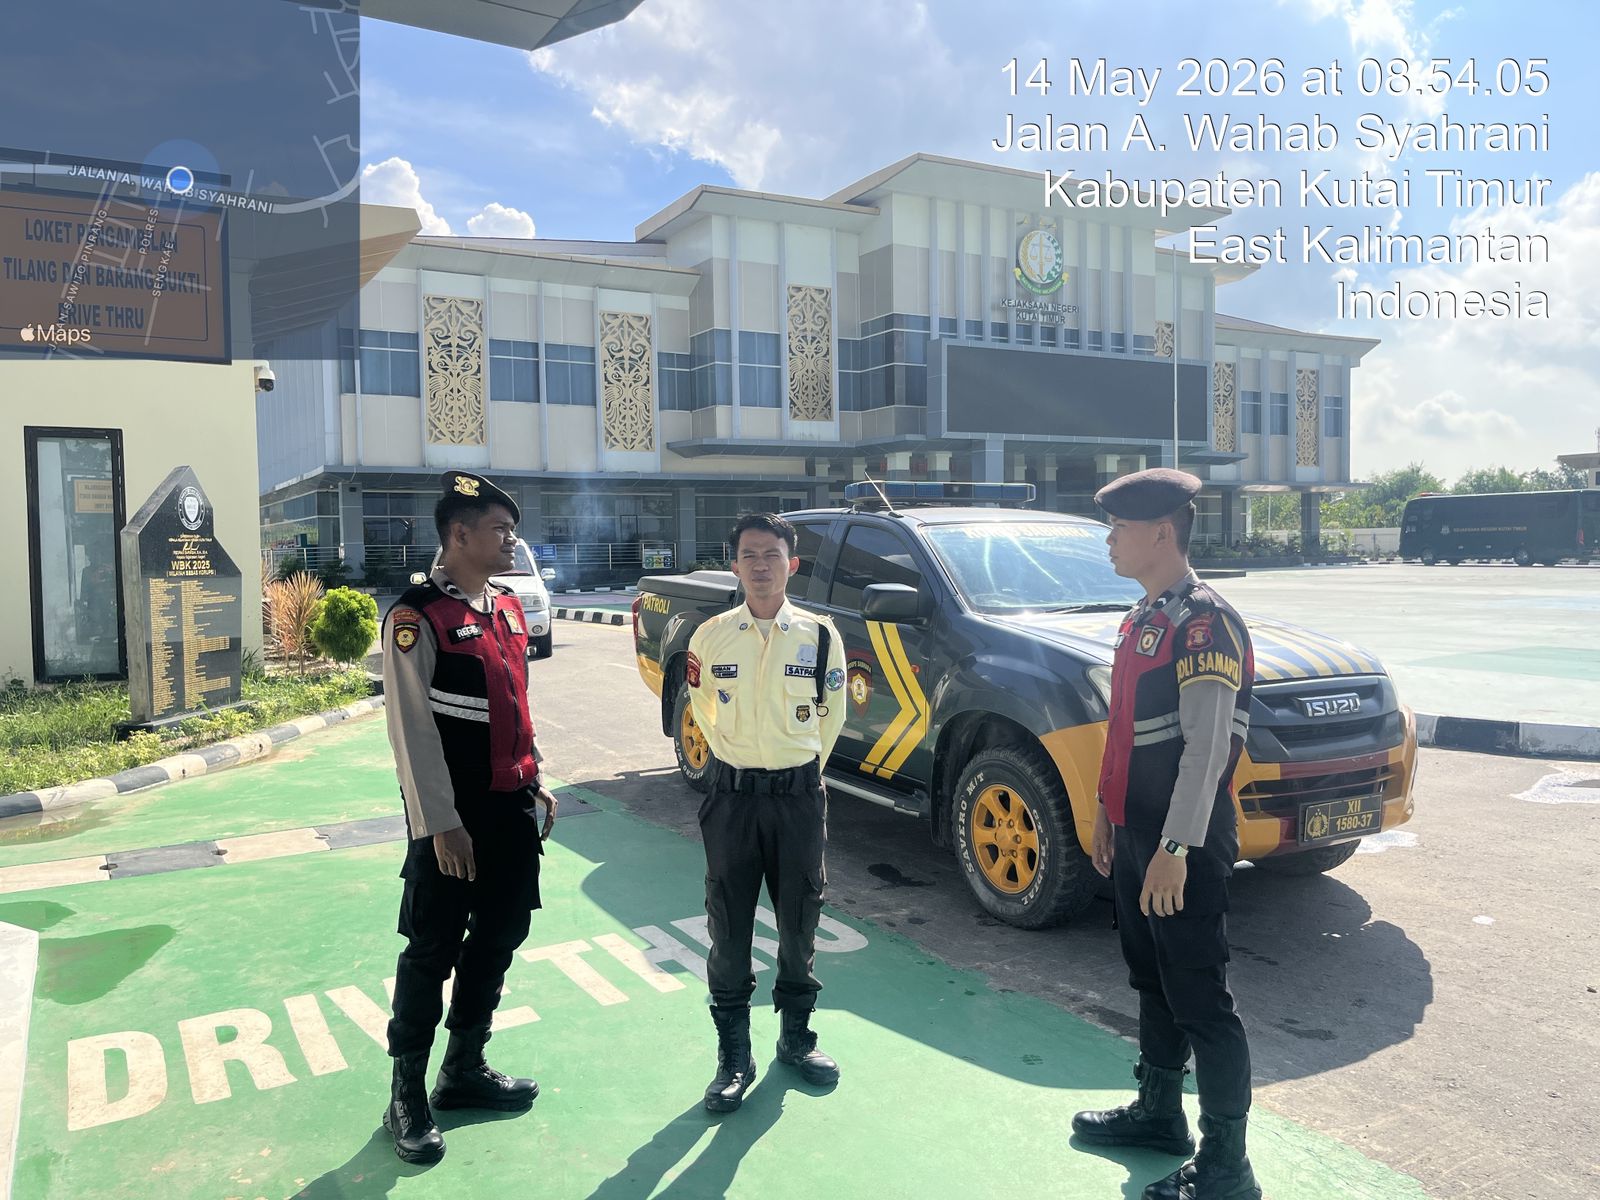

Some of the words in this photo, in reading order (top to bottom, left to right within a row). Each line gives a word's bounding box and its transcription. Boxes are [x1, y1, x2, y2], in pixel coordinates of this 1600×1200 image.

[25, 218, 72, 243] LOKET
[3, 257, 57, 282] TILANG
[97, 264, 154, 290] BARANG
[1001, 299, 1050, 311] KEJAKSAAN
[1052, 303, 1080, 313] NEGERI
[105, 305, 144, 329] THRU
[1016, 312, 1040, 321] KUTAI
[1040, 314, 1066, 324] TIMUR
[171, 560, 191, 570] WBK
[192, 560, 211, 570] 2025
[643, 593, 670, 615] PATROLI
[1305, 698, 1360, 717] ISUZU
[966, 772, 985, 796] M/T
[1346, 799, 1361, 814] XII
[1335, 813, 1373, 832] 1580-37
[958, 799, 976, 874] SAVERO
